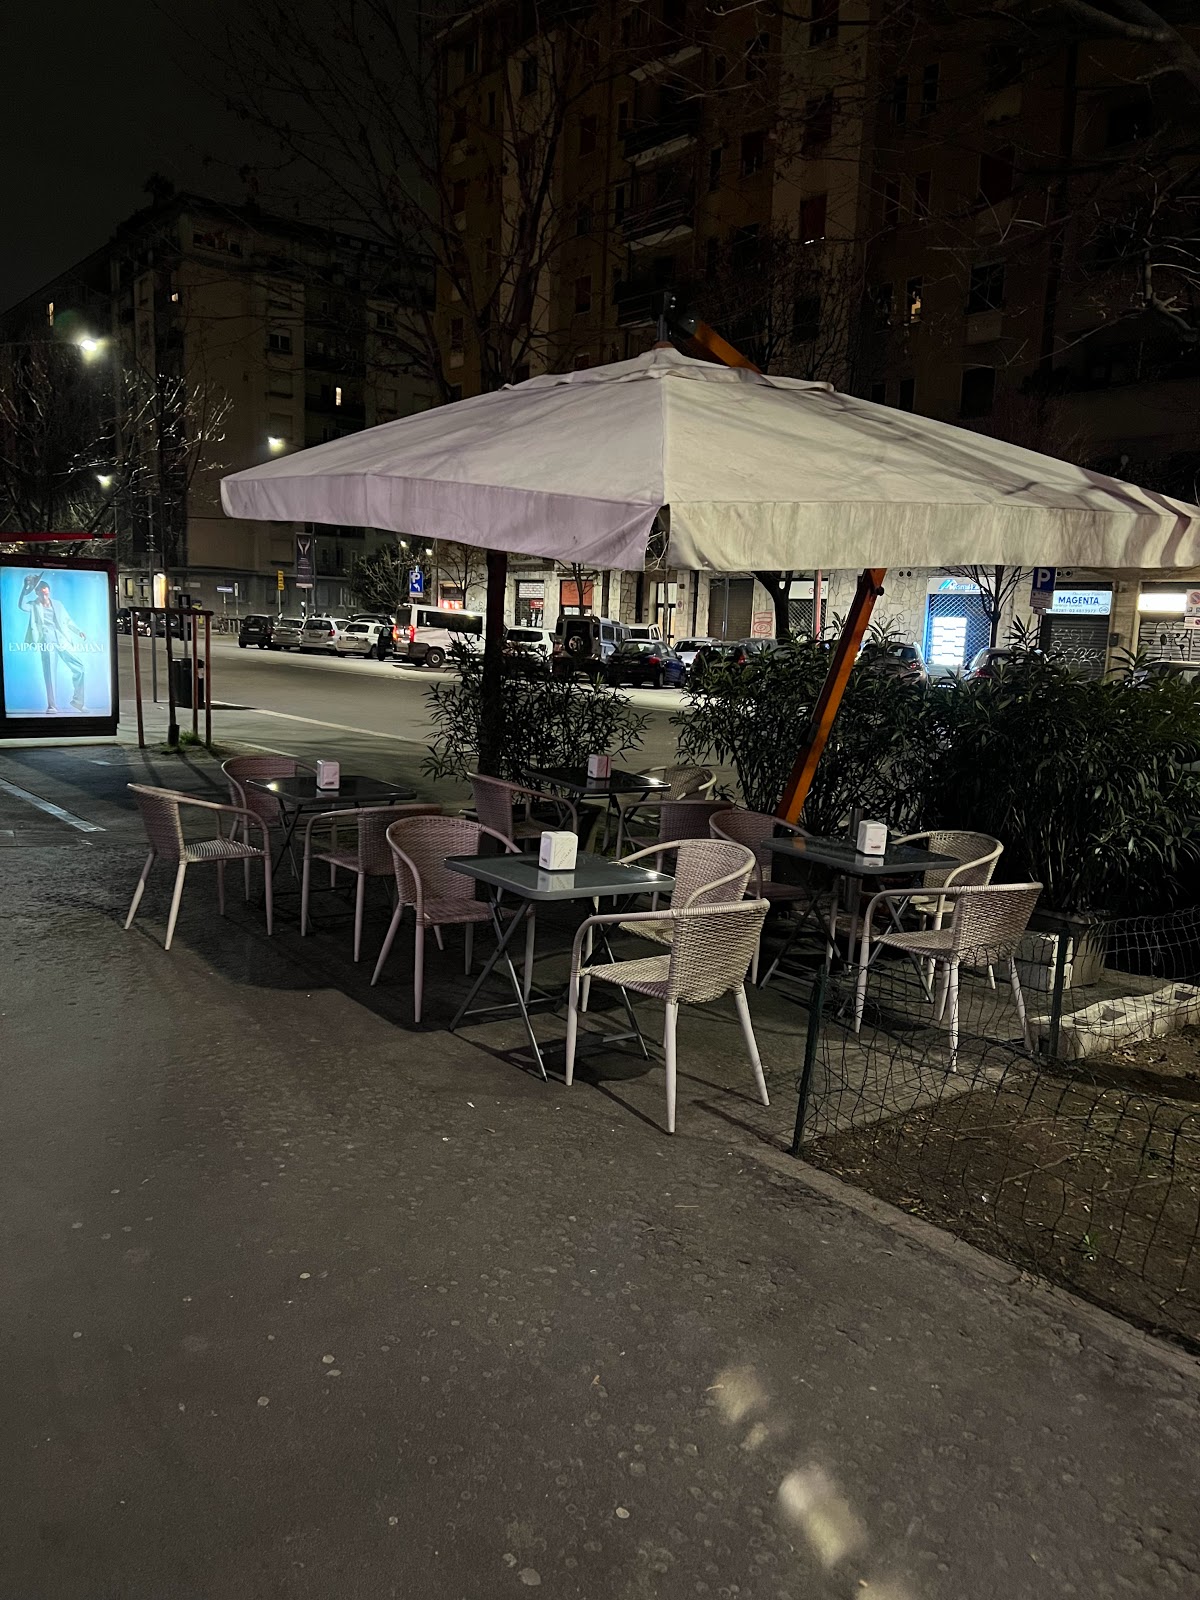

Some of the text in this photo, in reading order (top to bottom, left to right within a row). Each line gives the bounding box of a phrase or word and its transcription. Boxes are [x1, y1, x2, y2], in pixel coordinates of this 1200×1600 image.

[412, 572, 421, 583] P
[1036, 568, 1051, 588] P
[1058, 596, 1099, 604] MAGENTA
[9, 642, 105, 653] EMPORIO ARMANI
